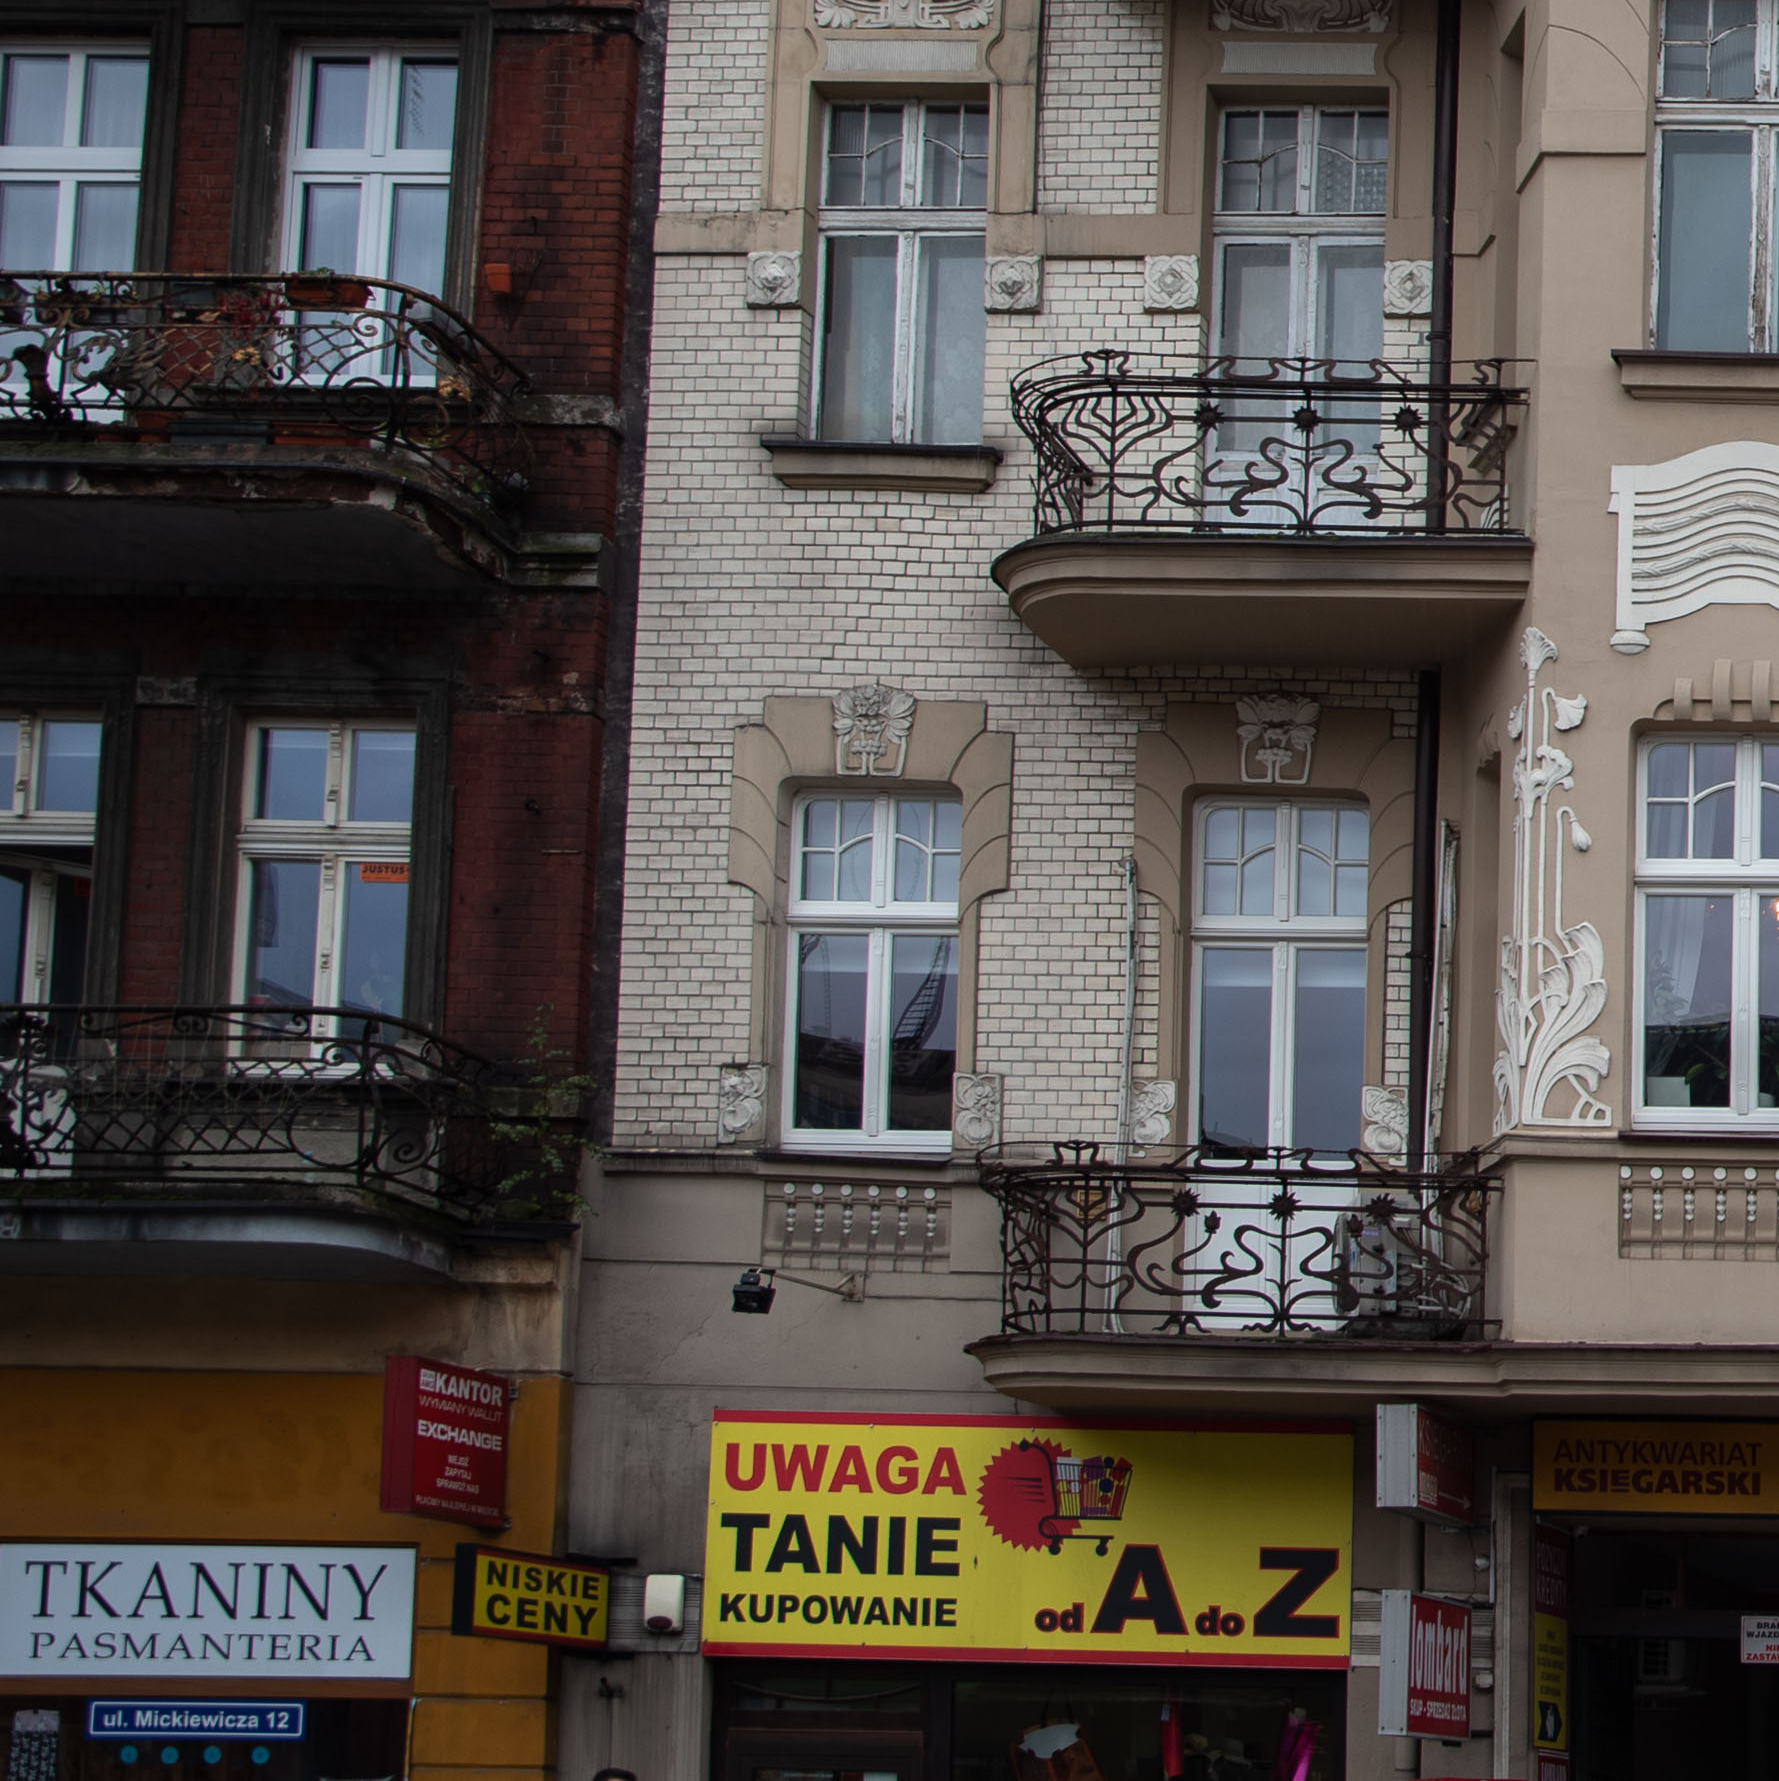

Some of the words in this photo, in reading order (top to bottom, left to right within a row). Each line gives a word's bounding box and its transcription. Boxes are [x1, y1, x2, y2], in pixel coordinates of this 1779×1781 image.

[361, 865, 405, 874] JUSTUS
[436, 1373, 502, 1407] KANTOR
[417, 1419, 503, 1450] EXCHANGE
[725, 1442, 967, 1496] UWAGA
[1553, 1439, 1763, 1466] ANTYKWARIAT
[1553, 1467, 1762, 1496] KSIĘGARSKI
[721, 1513, 961, 1578] TANIE
[25, 1559, 389, 1622] TKANINY
[486, 1560, 600, 1601] NISKIE
[1034, 1601, 1085, 1635] od
[1090, 1543, 1189, 1636] A
[1195, 1605, 1245, 1637] do
[1252, 1546, 1341, 1639] Z
[485, 1594, 598, 1636] CENY
[719, 1593, 958, 1628] KUPOWANIE
[29, 1631, 376, 1662] PASMANTERIA
[1410, 1604, 1468, 1695] lombard
[103, 1709, 129, 1729] ul.
[135, 1709, 260, 1729] Mickiewicza
[265, 1709, 290, 1729] 12
